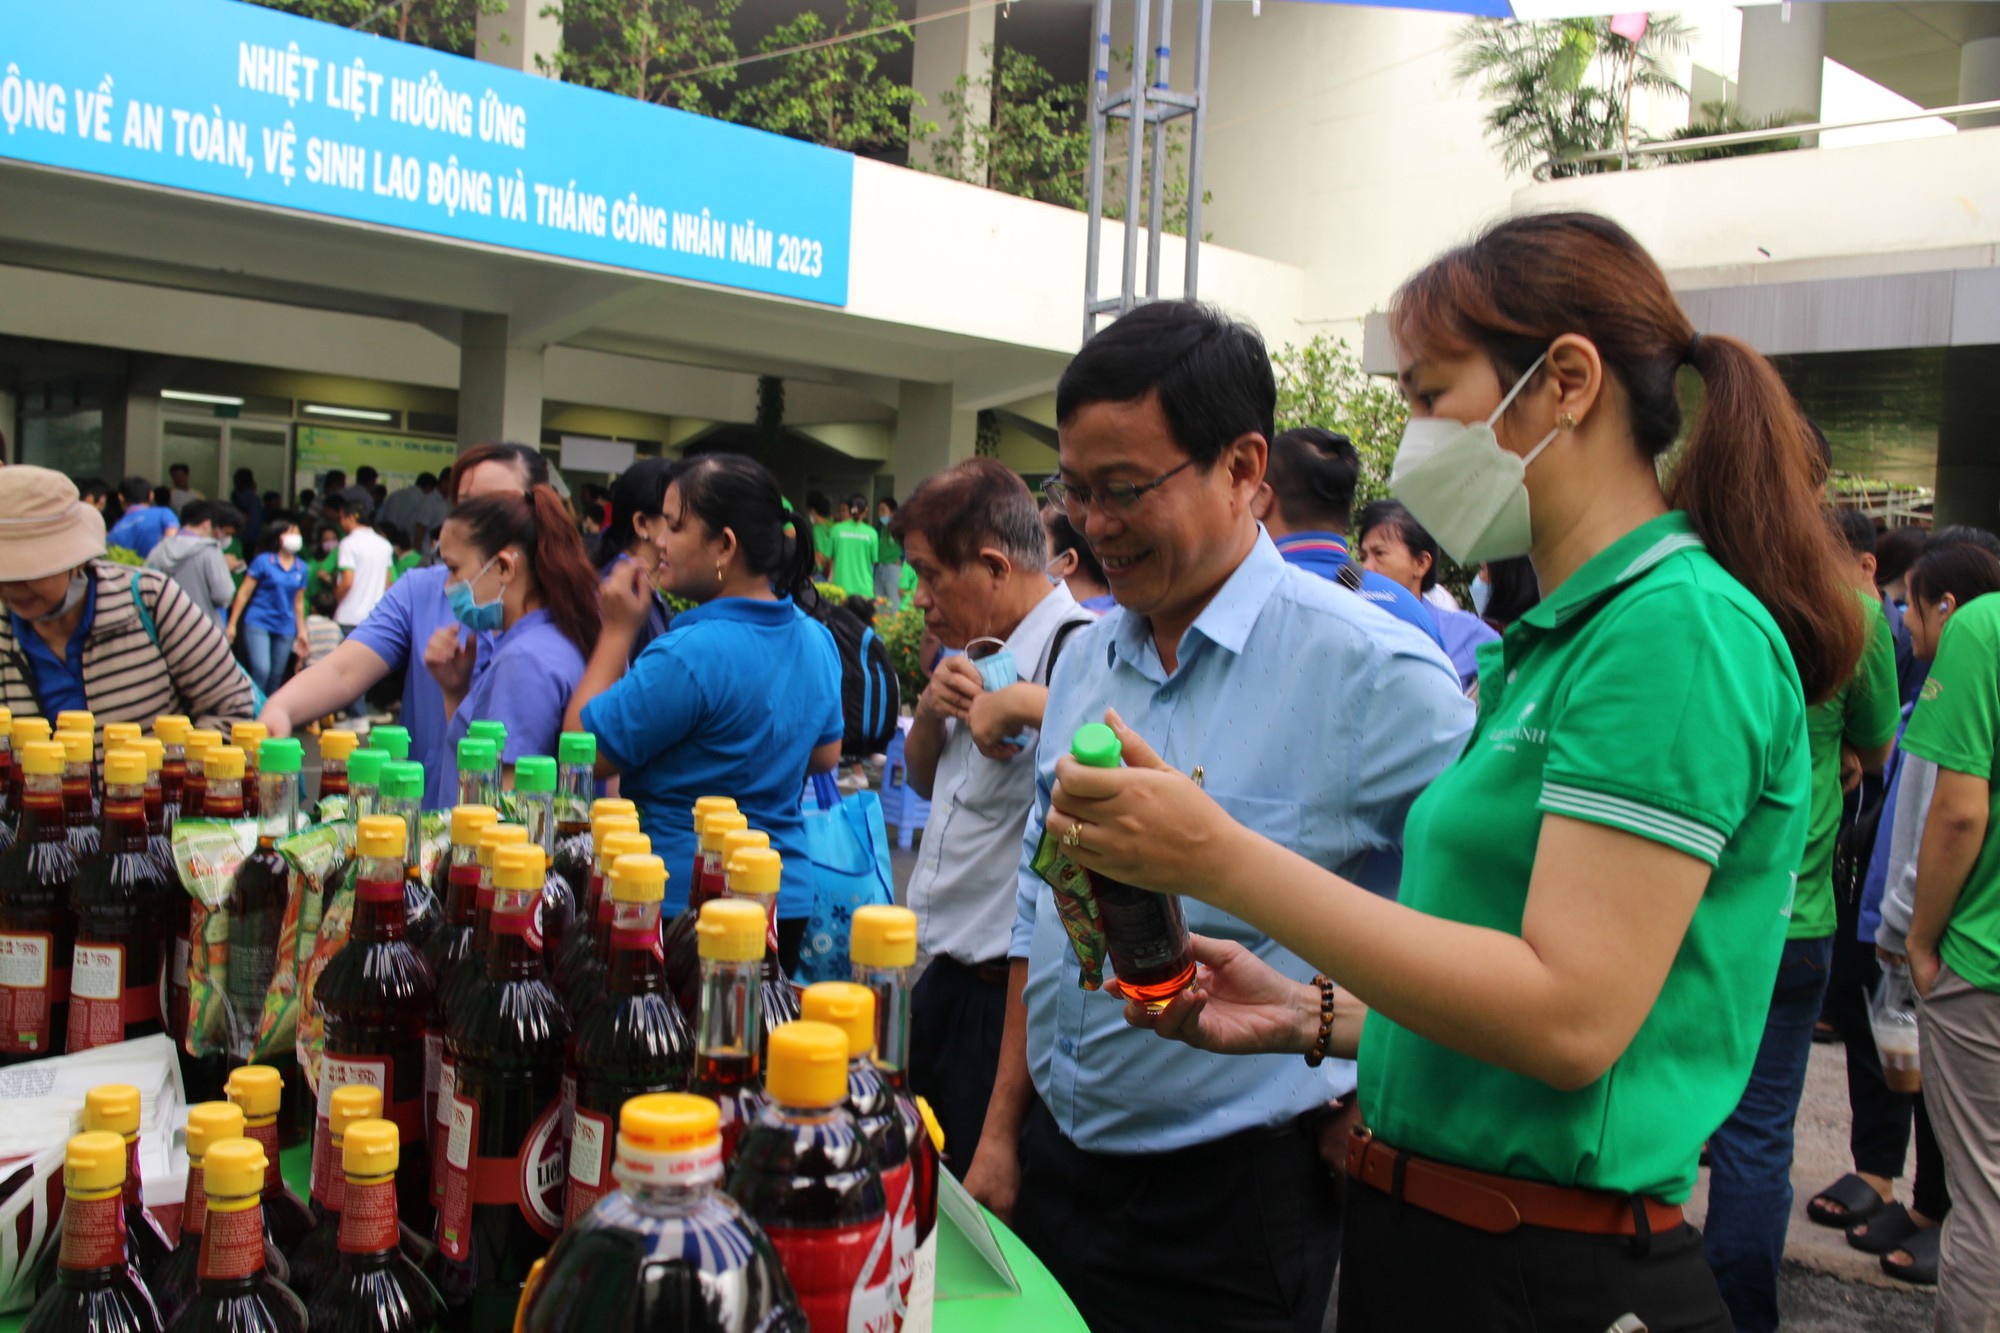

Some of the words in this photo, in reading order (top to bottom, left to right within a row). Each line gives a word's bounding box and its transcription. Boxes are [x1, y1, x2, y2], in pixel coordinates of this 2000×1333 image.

[238, 41, 320, 107] NHIỆT
[327, 57, 383, 122] LIỆT
[391, 69, 473, 138] HƯỞNG
[478, 88, 526, 150] ỨNG
[75, 73, 115, 143] VỀ
[123, 99, 164, 152] AN
[172, 104, 254, 179] TOÀN,
[263, 119, 297, 186] VỆ
[305, 137, 365, 192] SINH
[373, 150, 421, 202] LAO
[427, 155, 492, 218] ĐỘNG
[498, 168, 527, 222] VÀ
[534, 179, 607, 239] THÁNG
[611, 192, 667, 249] CÔNG
[672, 208, 726, 261] NHÂN
[730, 219, 773, 269] NĂM
[777, 234, 823, 278] 2023
